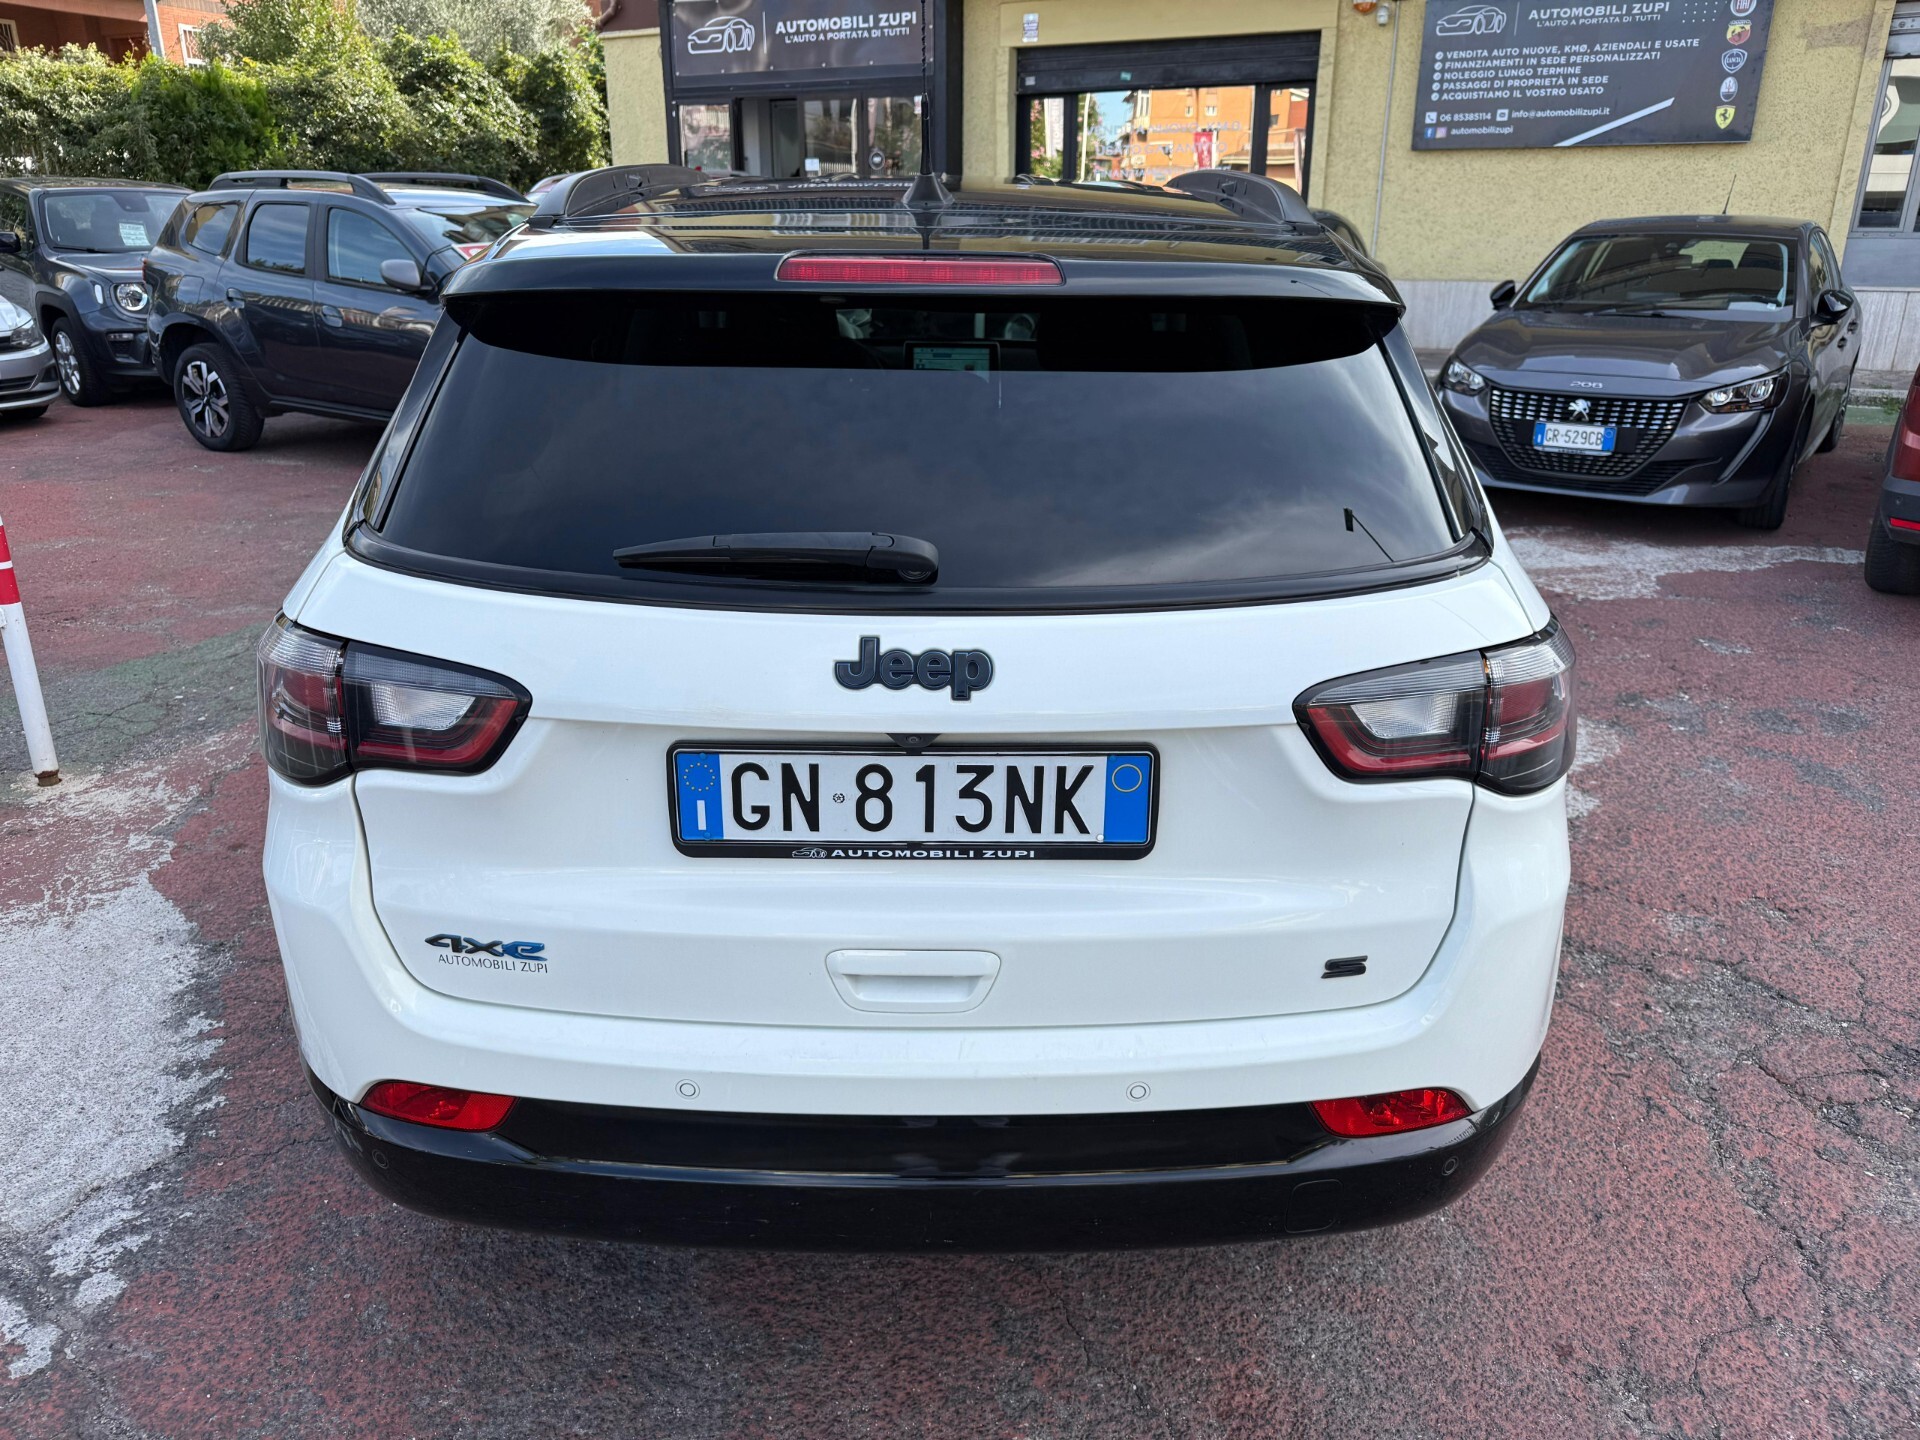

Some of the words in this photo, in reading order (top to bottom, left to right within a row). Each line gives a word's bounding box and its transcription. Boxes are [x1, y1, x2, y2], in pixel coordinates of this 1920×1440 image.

[1528, 4, 1627, 20] AUTOMOBILI
[1631, 1, 1670, 14] ZUPI
[775, 15, 873, 35] AUTOMOBILI
[878, 11, 917, 26] ZUPI
[1536, 19, 1569, 27] L'AUTO
[1579, 16, 1620, 25] PORTATA
[1622, 15, 1632, 23] DI
[1635, 14, 1661, 22] TUTTI
[785, 32, 816, 44] L'AUTO
[818, 33, 825, 41] A
[827, 29, 869, 41] PORTATA
[871, 28, 881, 37] DI
[883, 27, 909, 37] TUTTI
[1446, 49, 1489, 59] VENDITA
[1491, 47, 1520, 57] AUTO
[1522, 45, 1561, 55] NUOVE,
[1593, 41, 1651, 52] AZIENDALI
[1654, 40, 1661, 48] E
[1665, 38, 1700, 48] USATE
[1444, 58, 1523, 70] FINANZIAMENTI
[1526, 57, 1537, 65] IN
[1540, 56, 1567, 65] SEDE
[1570, 51, 1661, 63] PERSONALIZZATI
[1443, 69, 1496, 80] NOLEGGIO
[1498, 68, 1533, 78] LUNGO
[1536, 66, 1581, 75] TERMINE
[1442, 80, 1491, 90] PASSAGGI
[1493, 80, 1504, 88] DI
[1507, 76, 1565, 87] PROPRIETÀ
[1567, 76, 1578, 84] IN
[1582, 75, 1609, 84] SEDE
[1441, 90, 1510, 100] ACQUISTIAMO
[1513, 90, 1522, 98] IL
[1525, 88, 1566, 97] VOSTRO
[1570, 86, 1604, 95] USATO
[1440, 114, 1452, 122] 06
[1511, 107, 1610, 119] info@automobilizupi.it
[1450, 125, 1514, 136] automobilizupi
[1570, 381, 1603, 389] 208
[835, 636, 994, 701] Jeep
[731, 762, 820, 832] GN
[855, 764, 1095, 834] 813NK
[831, 850, 974, 858] AUTOMOBILI
[982, 850, 1035, 858] ZUPI
[439, 954, 516, 971] AUTOMOBILI
[520, 961, 548, 974] ZUPI
[1320, 955, 1368, 979] S
